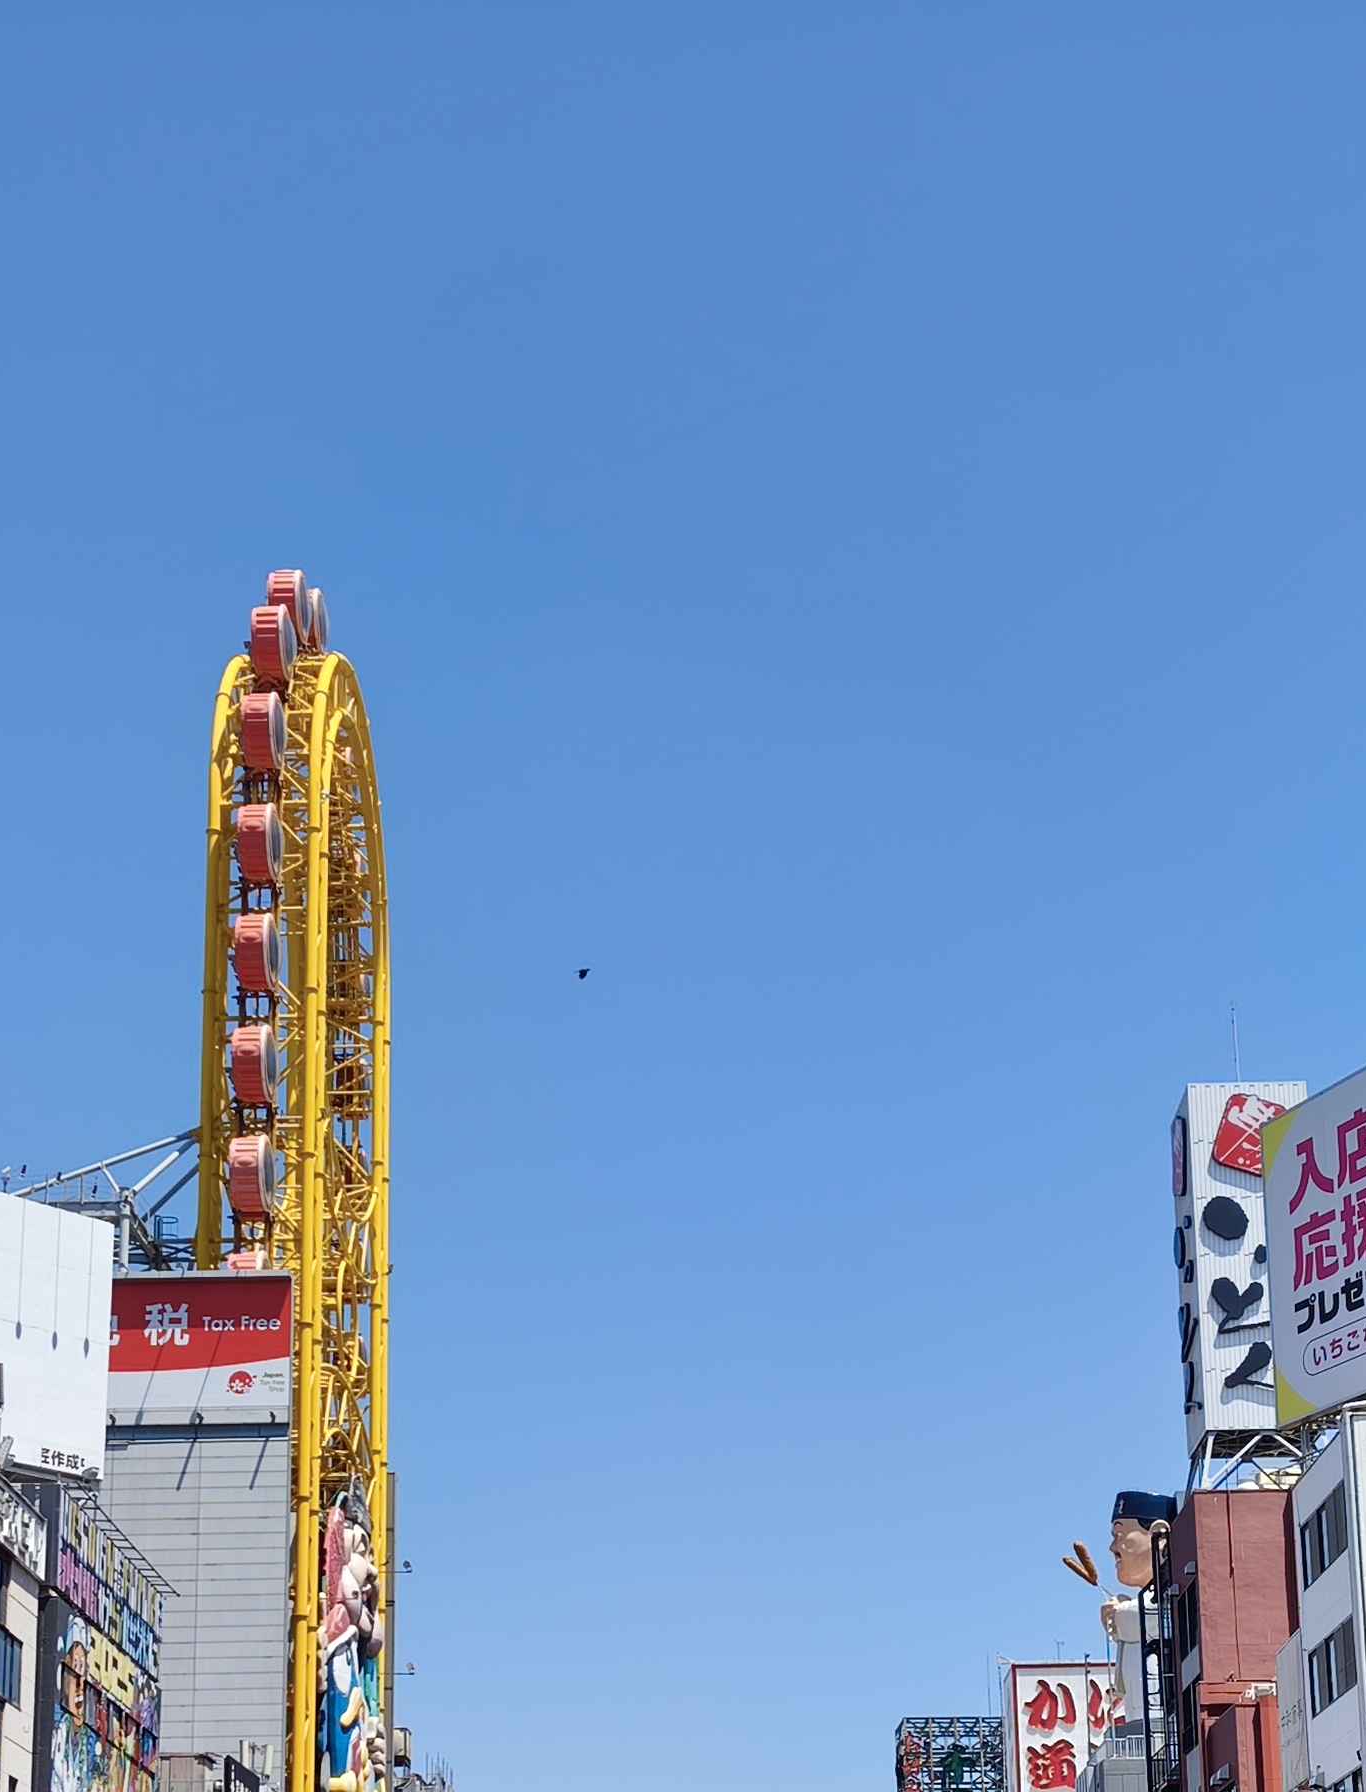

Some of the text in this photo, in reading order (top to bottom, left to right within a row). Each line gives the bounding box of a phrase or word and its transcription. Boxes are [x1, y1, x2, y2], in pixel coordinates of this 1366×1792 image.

[202, 1315, 281, 1331] Tax Free
[1028, 1738, 1080, 1791] 道
